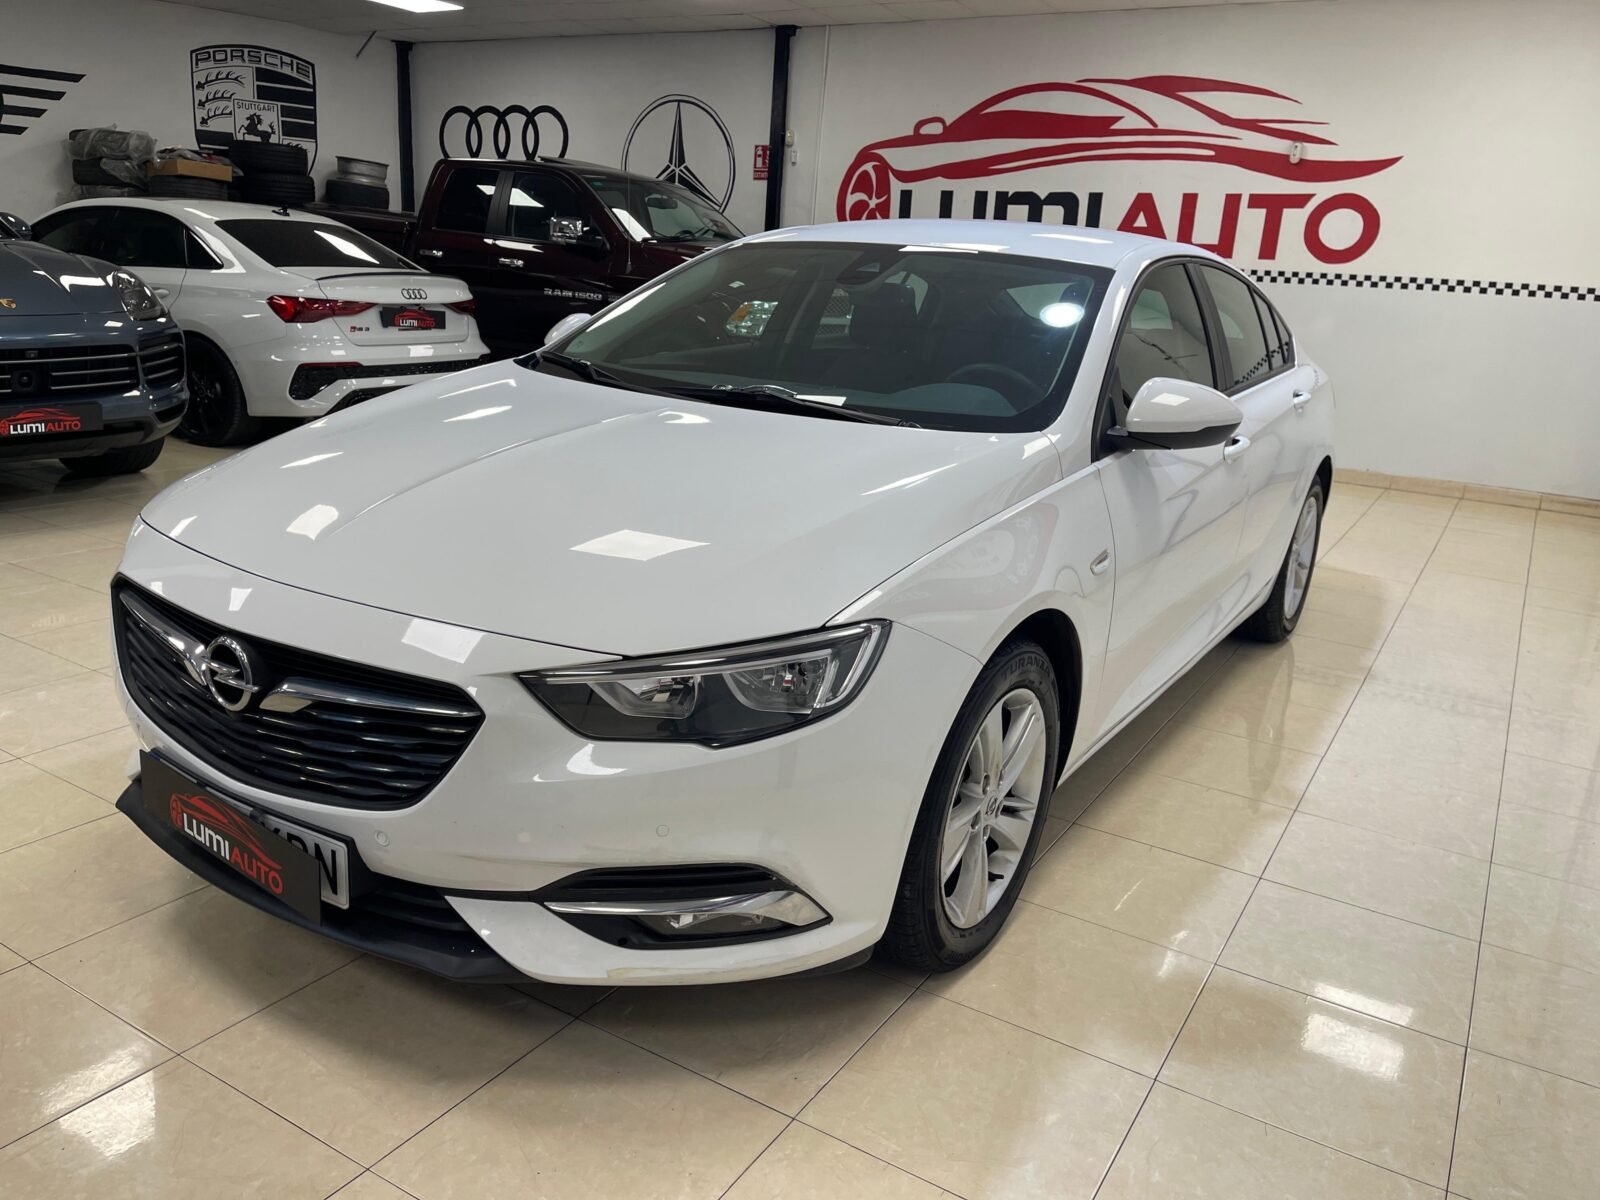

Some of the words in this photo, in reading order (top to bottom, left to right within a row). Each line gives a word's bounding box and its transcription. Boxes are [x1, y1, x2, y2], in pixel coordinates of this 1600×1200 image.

[194, 49, 311, 79] PORSCHE
[236, 101, 276, 113] STUTTGART
[543, 287, 573, 298] RAM
[575, 291, 603, 301] 1500
[400, 319, 436, 328] LUMIAUTO
[10, 421, 81, 435] LUMIAUTO
[1000, 655, 1051, 681] TURANZA
[183, 812, 284, 895] LUMIAUTO
